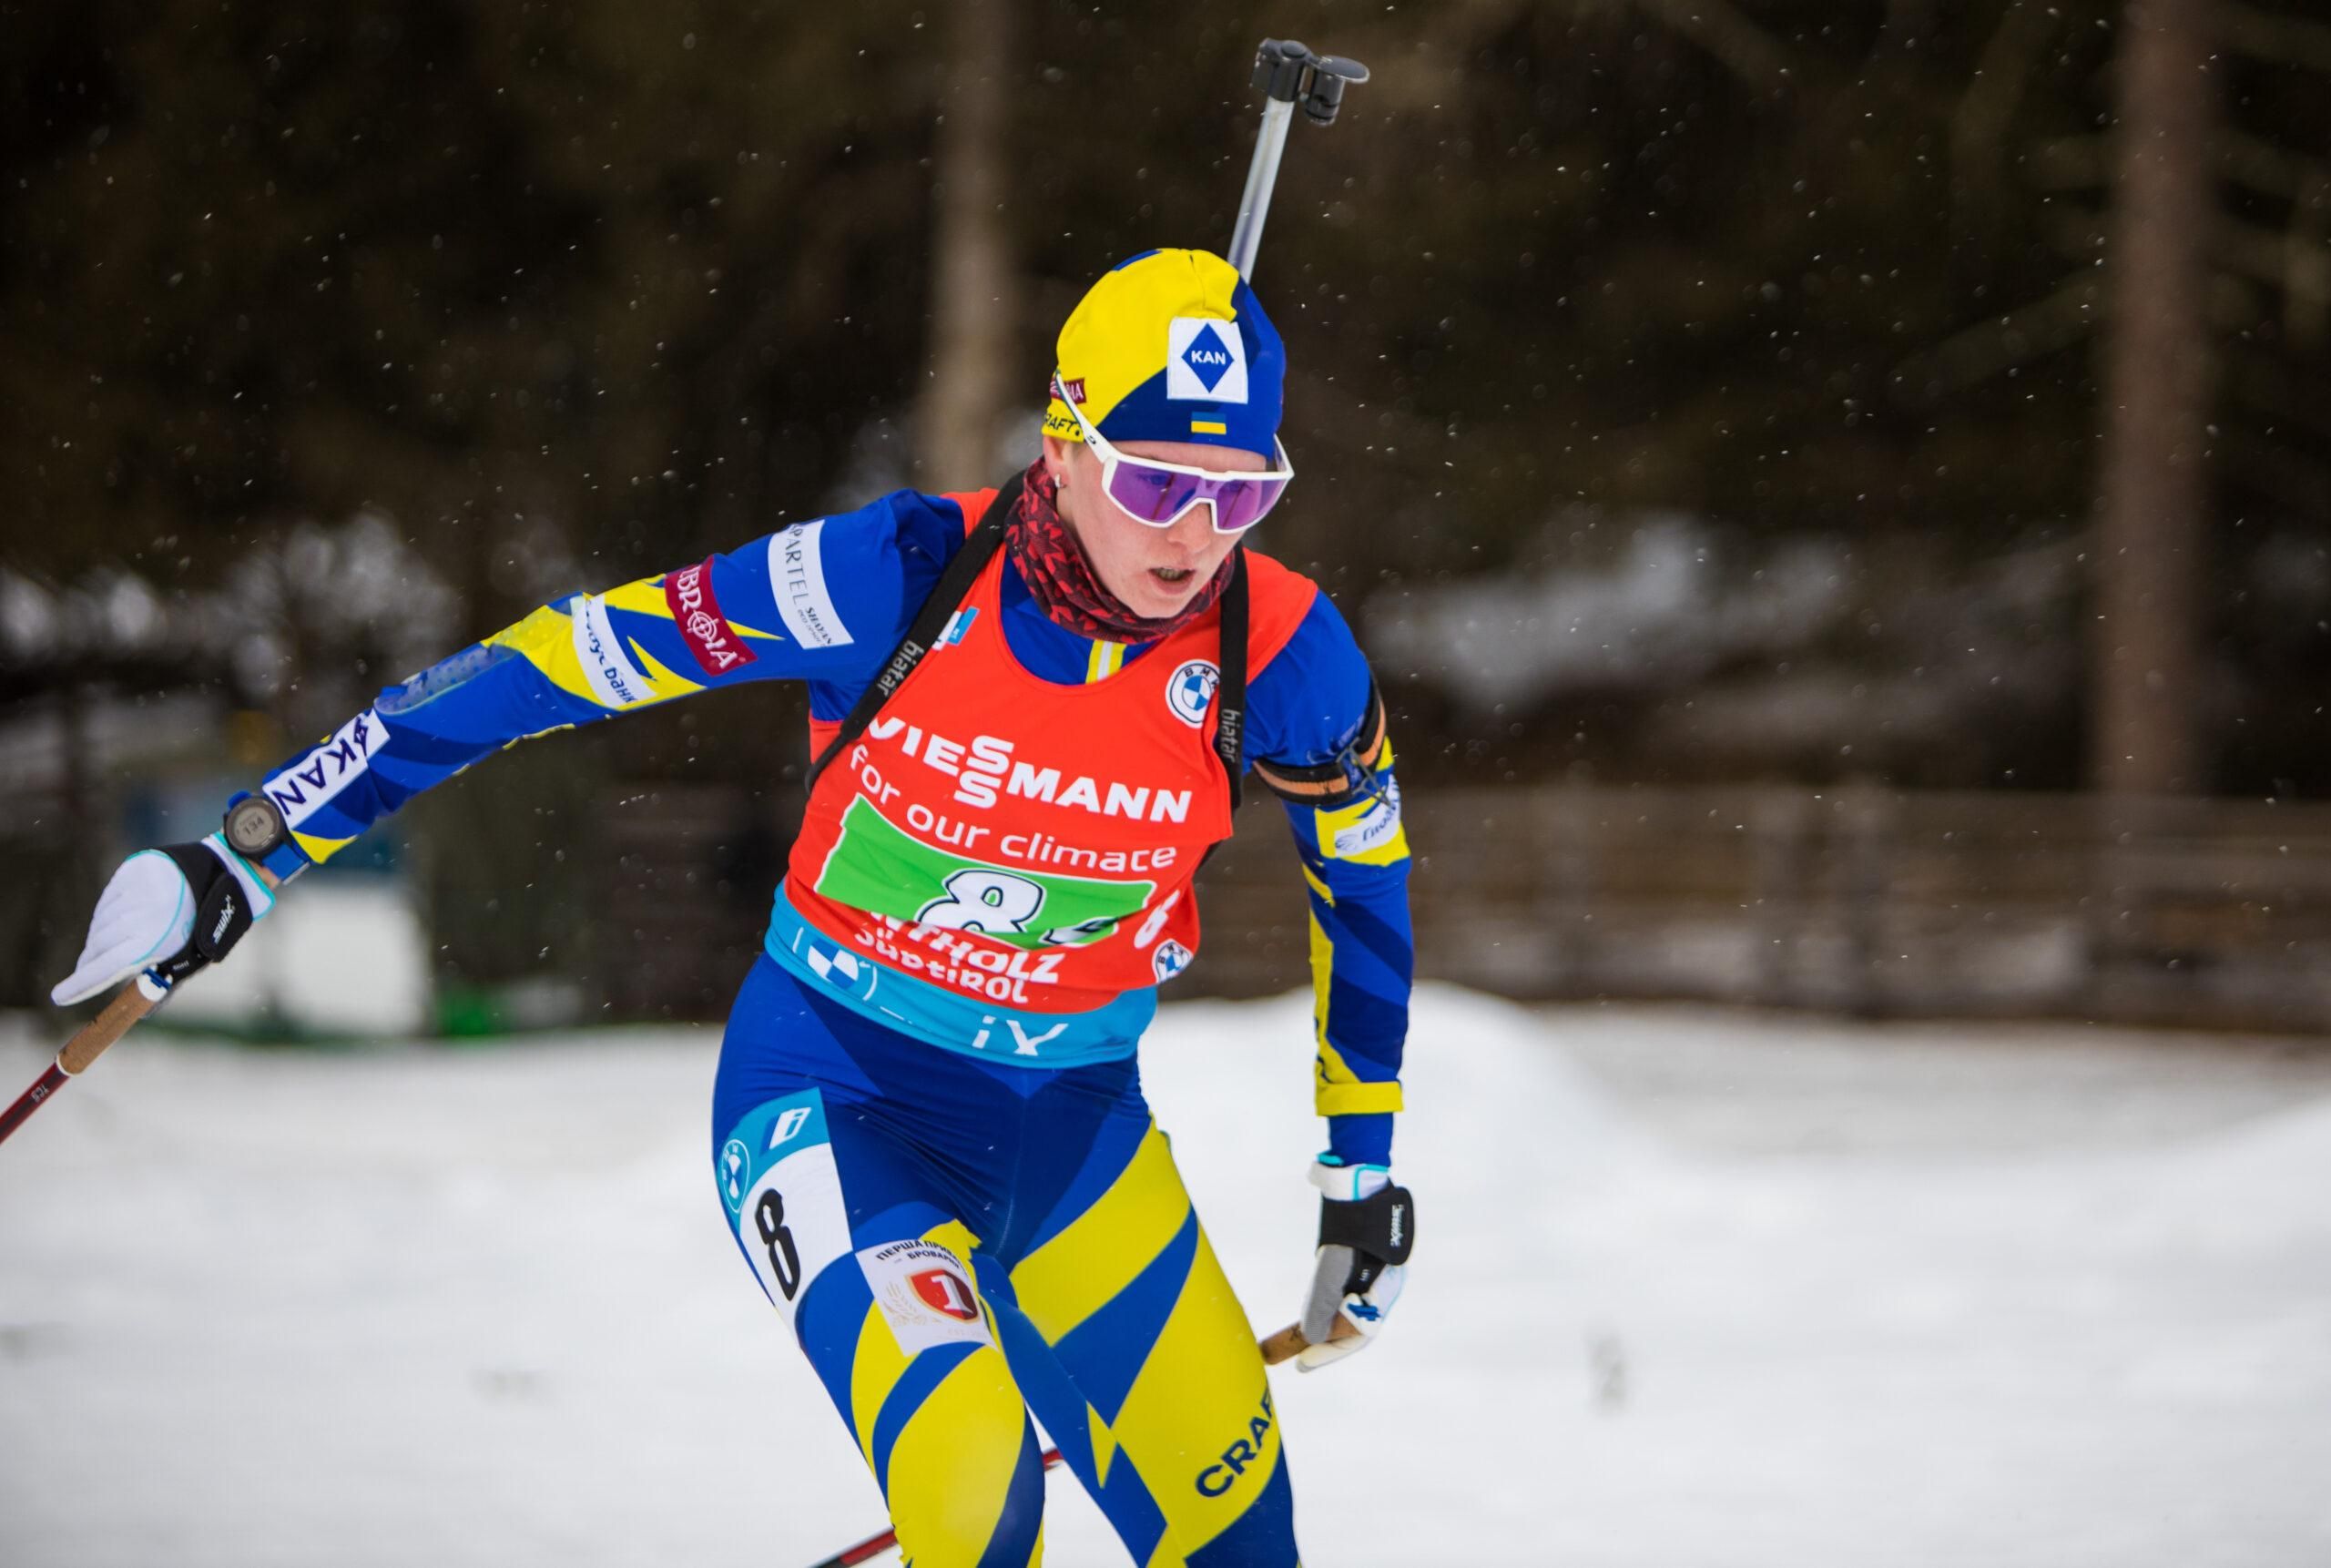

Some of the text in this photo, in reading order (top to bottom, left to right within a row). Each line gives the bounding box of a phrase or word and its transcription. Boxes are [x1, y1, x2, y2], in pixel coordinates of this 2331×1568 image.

[1191, 350, 1227, 365] KAN
[1044, 413, 1078, 432] RAFT
[677, 565, 738, 669] BROIA
[272, 737, 357, 816] KAN
[850, 743, 1177, 872] for our climate
[870, 911, 1065, 983] THOLZ
[755, 1187, 801, 1302] 8
[875, 1240, 923, 1261] ПЕРША
[930, 1274, 974, 1314] 1
[1195, 1385, 1273, 1498] CRAF
